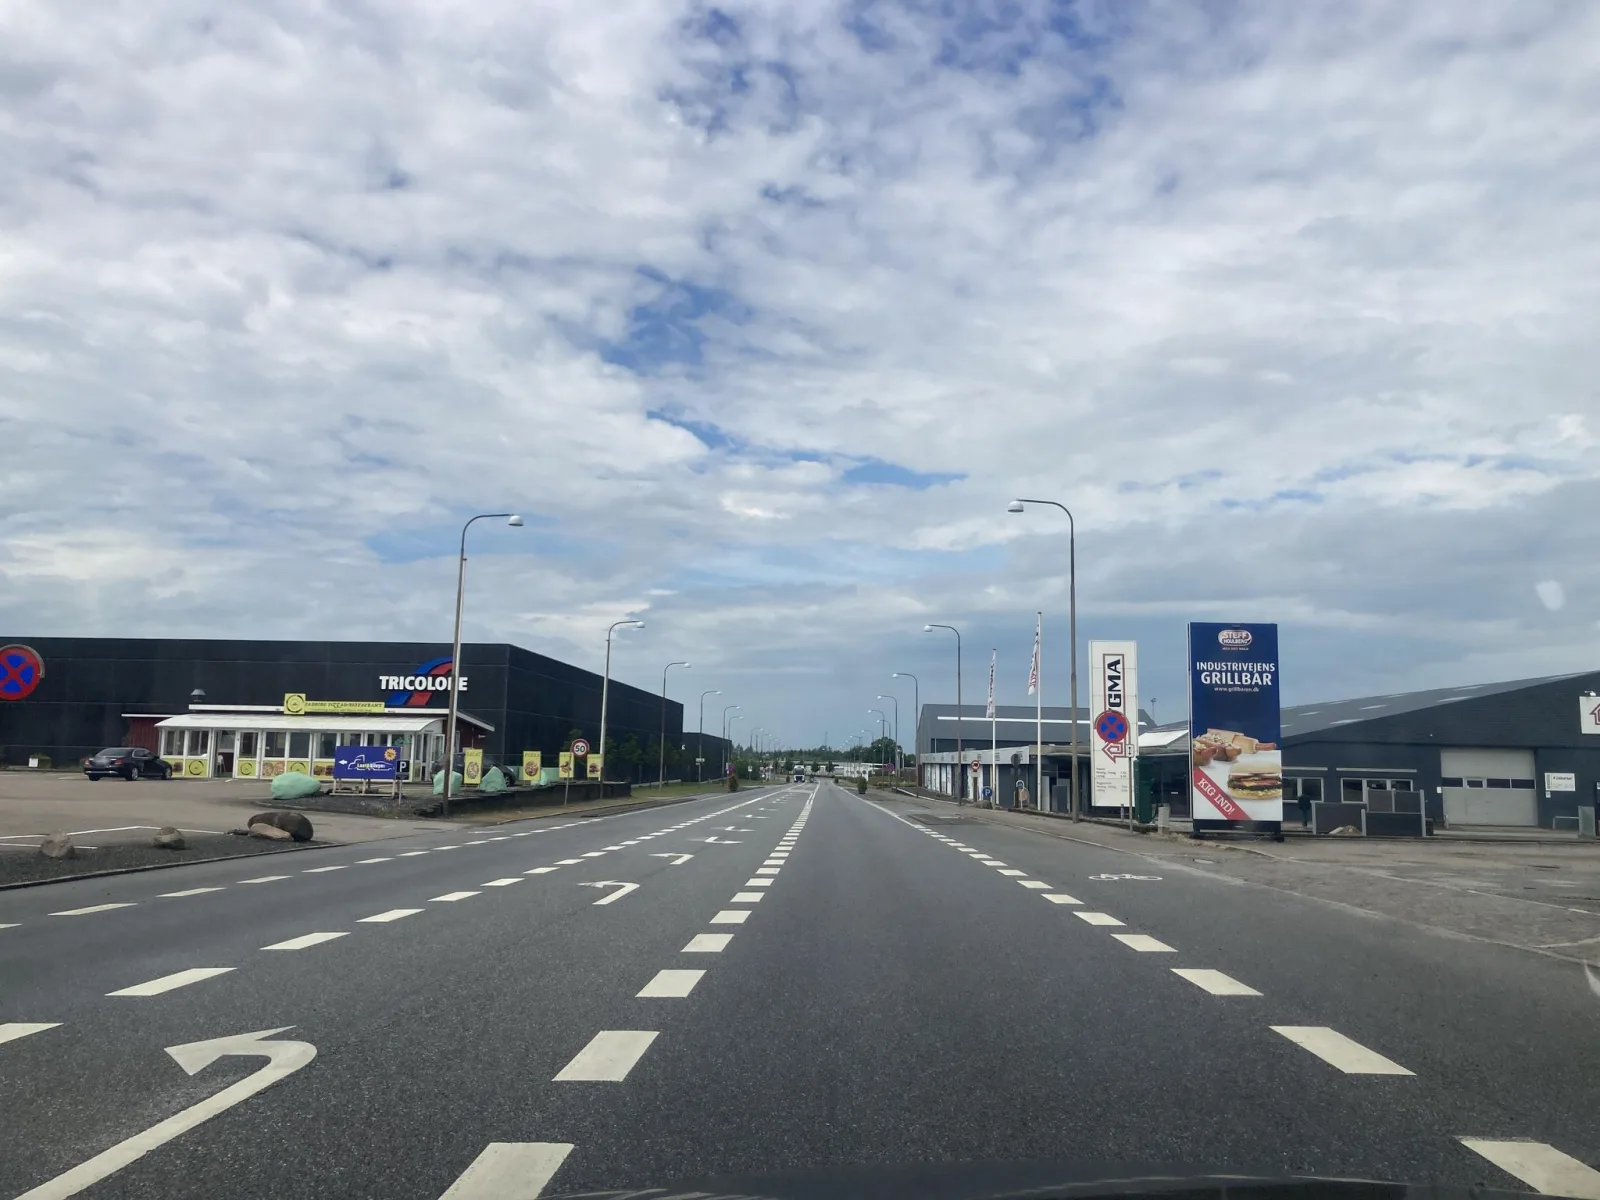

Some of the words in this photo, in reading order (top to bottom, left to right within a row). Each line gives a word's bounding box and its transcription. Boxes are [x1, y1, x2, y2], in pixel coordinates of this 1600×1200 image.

[1196, 662, 1275, 673] INDUSTRIVEJENS
[1107, 659, 1122, 709] GMA
[1201, 672, 1272, 685] GRILLBAR
[574, 744, 585, 753] 50
[400, 762, 406, 772] P
[985, 789, 991, 797] P
[1198, 778, 1216, 796] KIG
[1214, 794, 1235, 814] IND!
